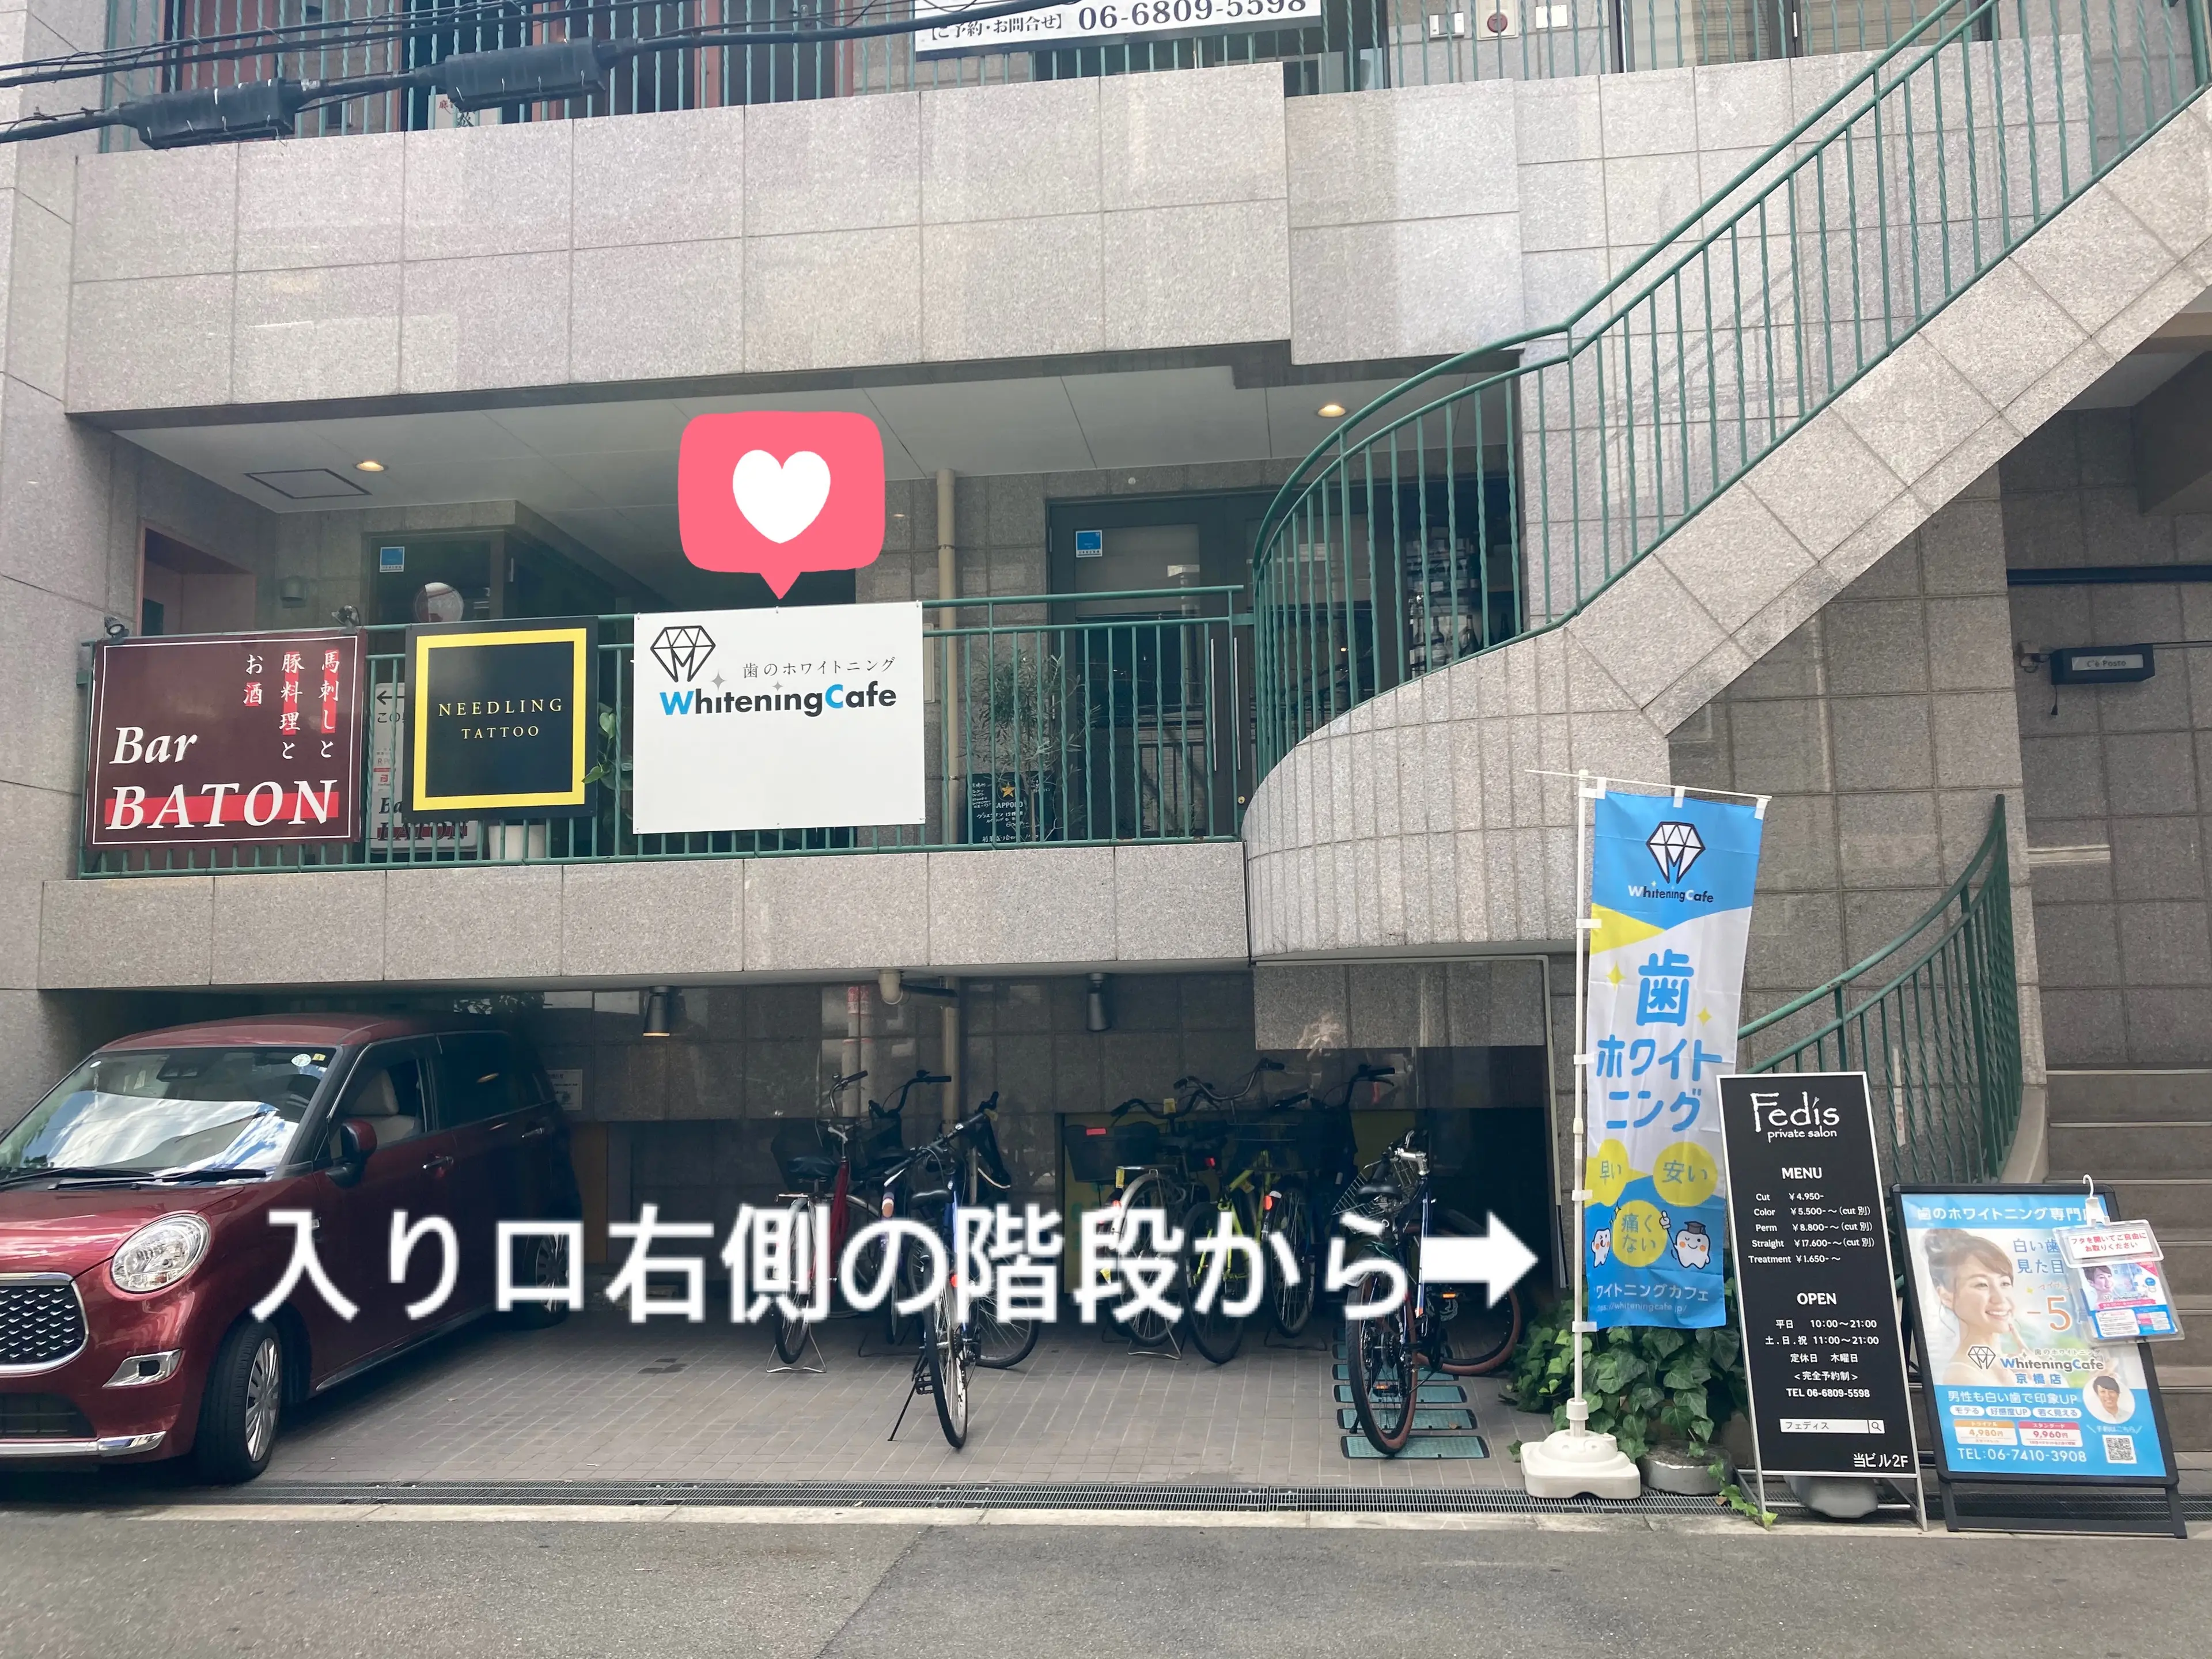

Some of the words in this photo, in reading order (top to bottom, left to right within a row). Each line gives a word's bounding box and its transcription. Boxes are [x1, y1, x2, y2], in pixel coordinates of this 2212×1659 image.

[743, 657, 896, 679] 歯のホワイトニング
[243, 656, 263, 706] お酒
[279, 653, 305, 759] 豚料理と
[319, 650, 340, 758] 馬刺しと
[660, 680, 896, 717] WhiteningCafe
[439, 698, 562, 716] NEEDLING
[377, 712, 404, 723] この
[462, 725, 539, 739] TATTOO
[109, 726, 198, 764] Bar
[105, 779, 338, 831] BATON
[1628, 885, 1714, 903] WhiteningCafe
[1636, 949, 1694, 1027] 歯
[1596, 1035, 1722, 1081] ホワイト
[1606, 1089, 1702, 1132] ニング
[1767, 1129, 1805, 1143] private
[1808, 1126, 1838, 1138] salon
[1600, 1160, 1622, 1185] 早い
[1662, 1160, 1708, 1184] 安い
[1781, 1167, 1823, 1180] MENU
[1756, 1193, 1770, 1201] Cut
[1753, 1208, 1775, 1216] Color
[1918, 1207, 2088, 1221] 歯のホワイトニング専門
[1621, 1213, 1652, 1233] 痛く
[1755, 1224, 1777, 1232] Perm
[1623, 1234, 1656, 1253] ない
[1752, 1239, 1784, 1249] Straight
[1748, 1255, 1791, 1264] Treatment
[2017, 1259, 2065, 1274] 見た目
[1596, 1283, 1709, 1301] ワイトニングカフェ
[1797, 1293, 1837, 1305] OPEN
[1775, 1320, 1793, 1329] 平日
[1790, 1353, 1817, 1363] 定休日
[1830, 1353, 1858, 1363] 木曜日
[2000, 1358, 2104, 1372] WhiteningCafe
[2016, 1374, 2061, 1384] 京橋店
[1786, 1388, 1805, 1396] TEL
[1806, 1388, 1870, 1397] 06-6809-5598
[1948, 1391, 2077, 1404] 男性も白い歯で印象UP
[1785, 1421, 1830, 1430] フェディス
[1969, 1429, 2003, 1437] 4,980円
[1853, 1453, 1908, 1468] 当ビル2F
